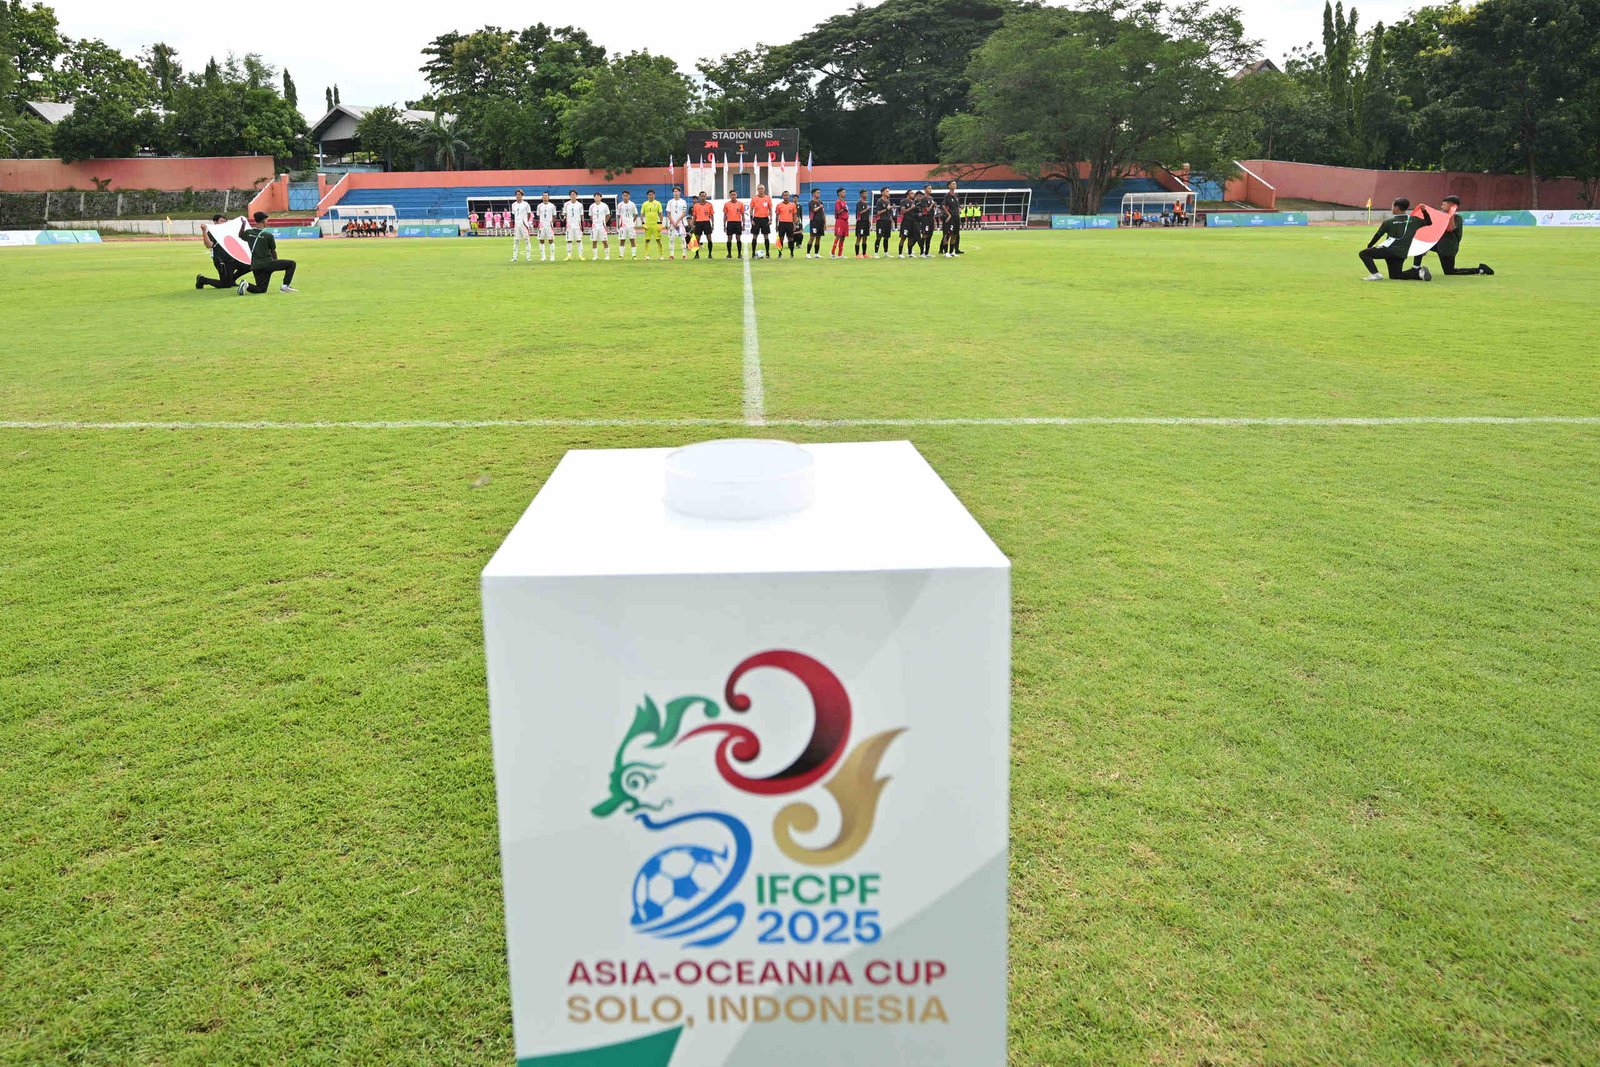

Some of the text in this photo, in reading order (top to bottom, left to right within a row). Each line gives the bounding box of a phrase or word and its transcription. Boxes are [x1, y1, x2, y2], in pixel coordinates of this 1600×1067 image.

[712, 131, 774, 140] STADION UNS
[1568, 211, 1596, 221] IFCPF
[756, 873, 880, 905] IFCPF
[757, 909, 882, 944] 2025
[568, 959, 947, 986] ASIA-OCEANIA CUP
[567, 994, 949, 1028] SOLO, INDONESIA
